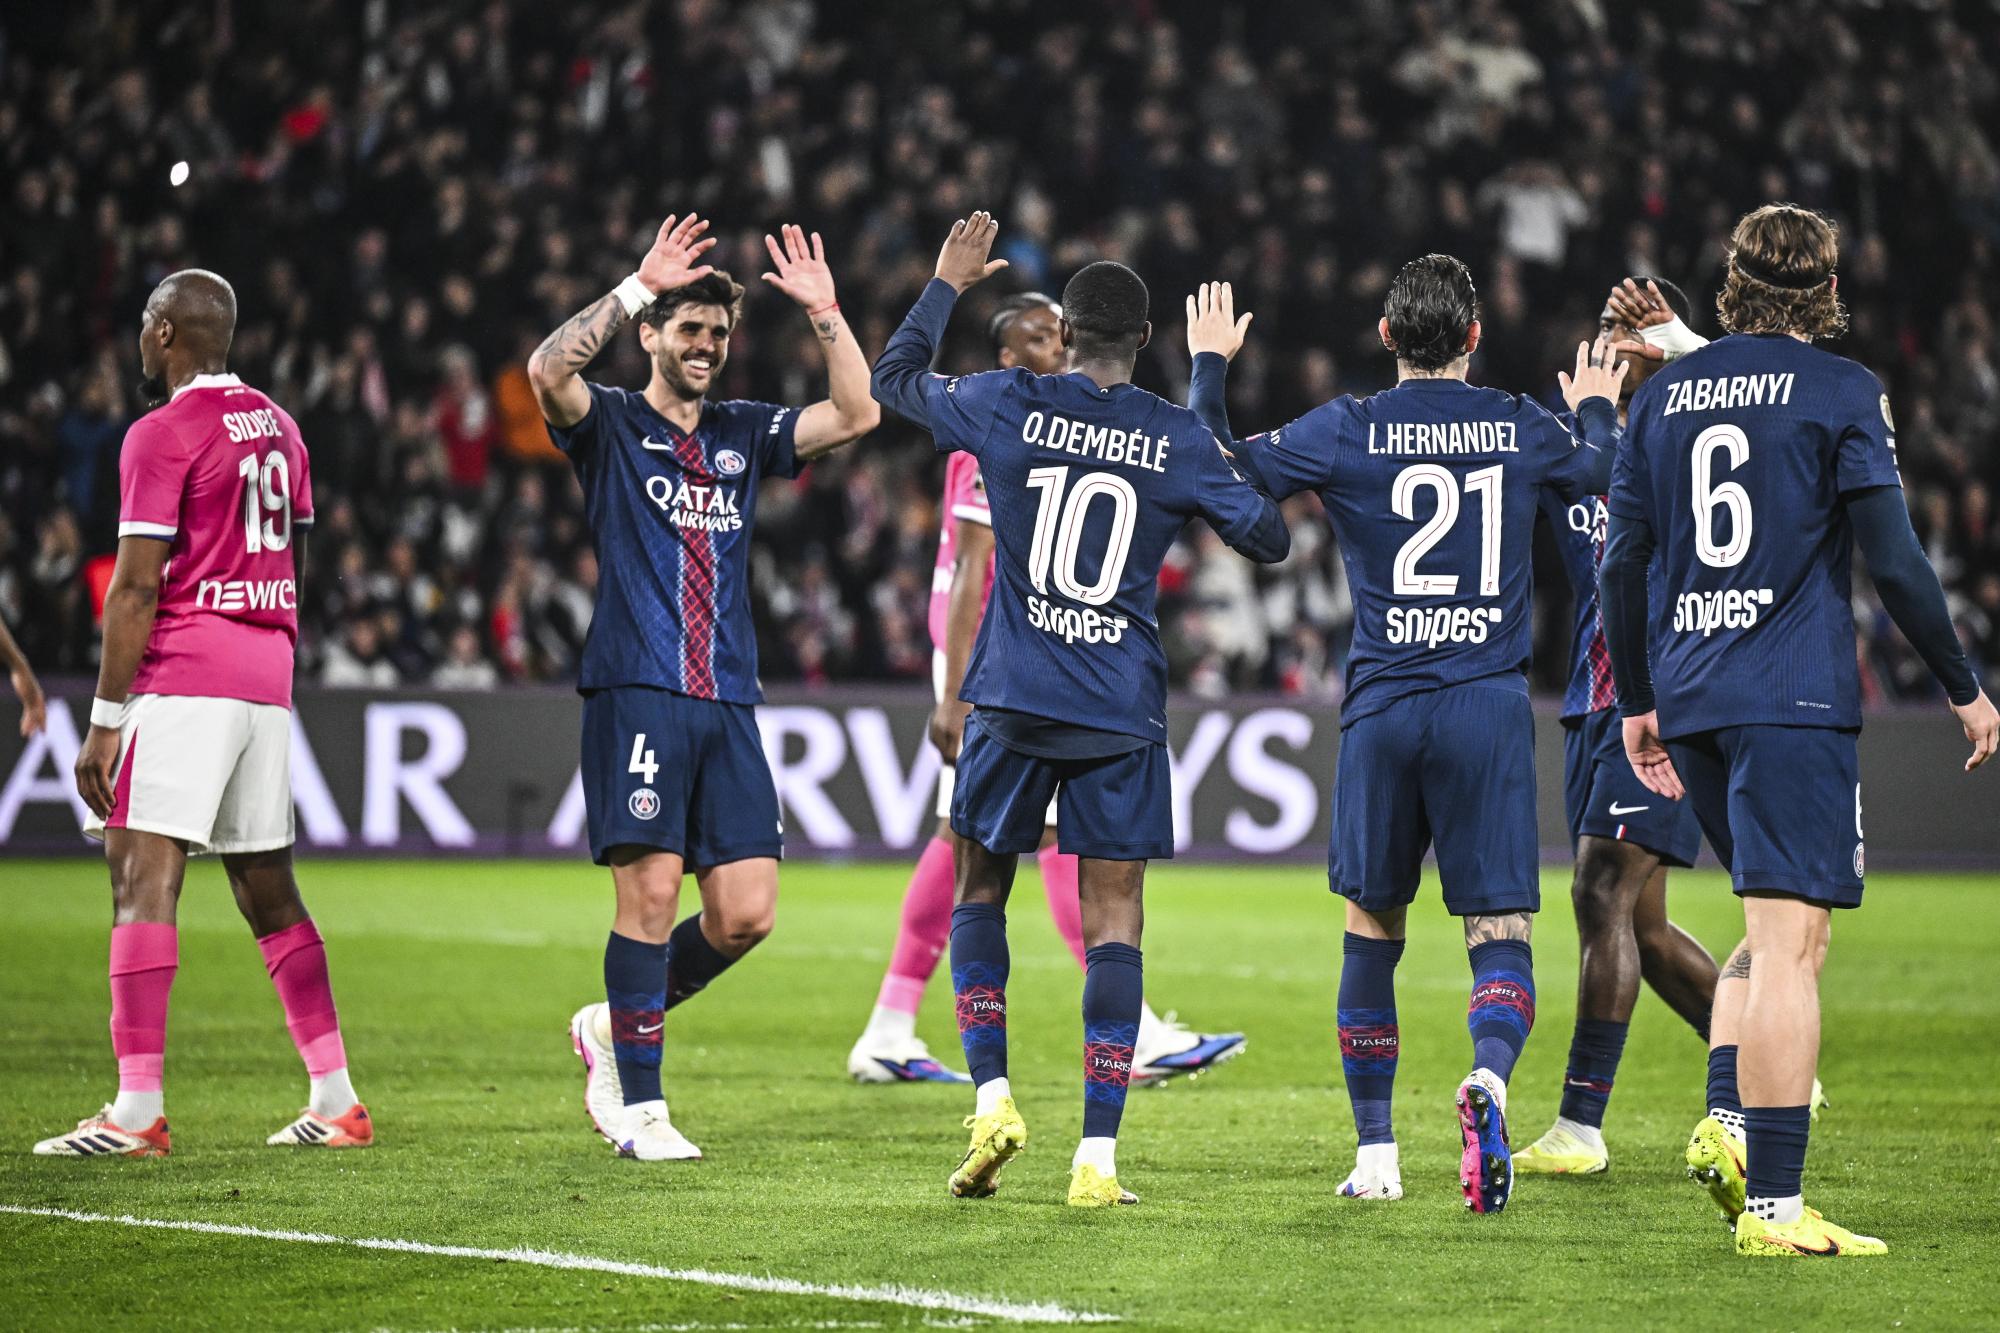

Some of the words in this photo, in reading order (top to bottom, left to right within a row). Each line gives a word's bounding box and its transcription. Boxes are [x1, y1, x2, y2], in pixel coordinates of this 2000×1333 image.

[1664, 373, 1795, 417] ZABARNYI
[1022, 411, 1170, 473] O.DEMBÉLÉ
[1368, 422, 1520, 455] L.HERNANDEZ
[239, 450, 291, 554] 19
[1691, 423, 1753, 568] 6
[669, 508, 743, 532] AIRWAYS
[1026, 466, 1138, 606] 10
[1391, 464, 1504, 596] 21
[1027, 595, 1124, 643] snipes
[1386, 606, 1490, 648] snipes
[1674, 589, 1760, 636] snipes
[628, 733, 660, 784] 4
[1094, 1057, 1132, 1072] PARIS
[1352, 1036, 1398, 1047] PARIS
